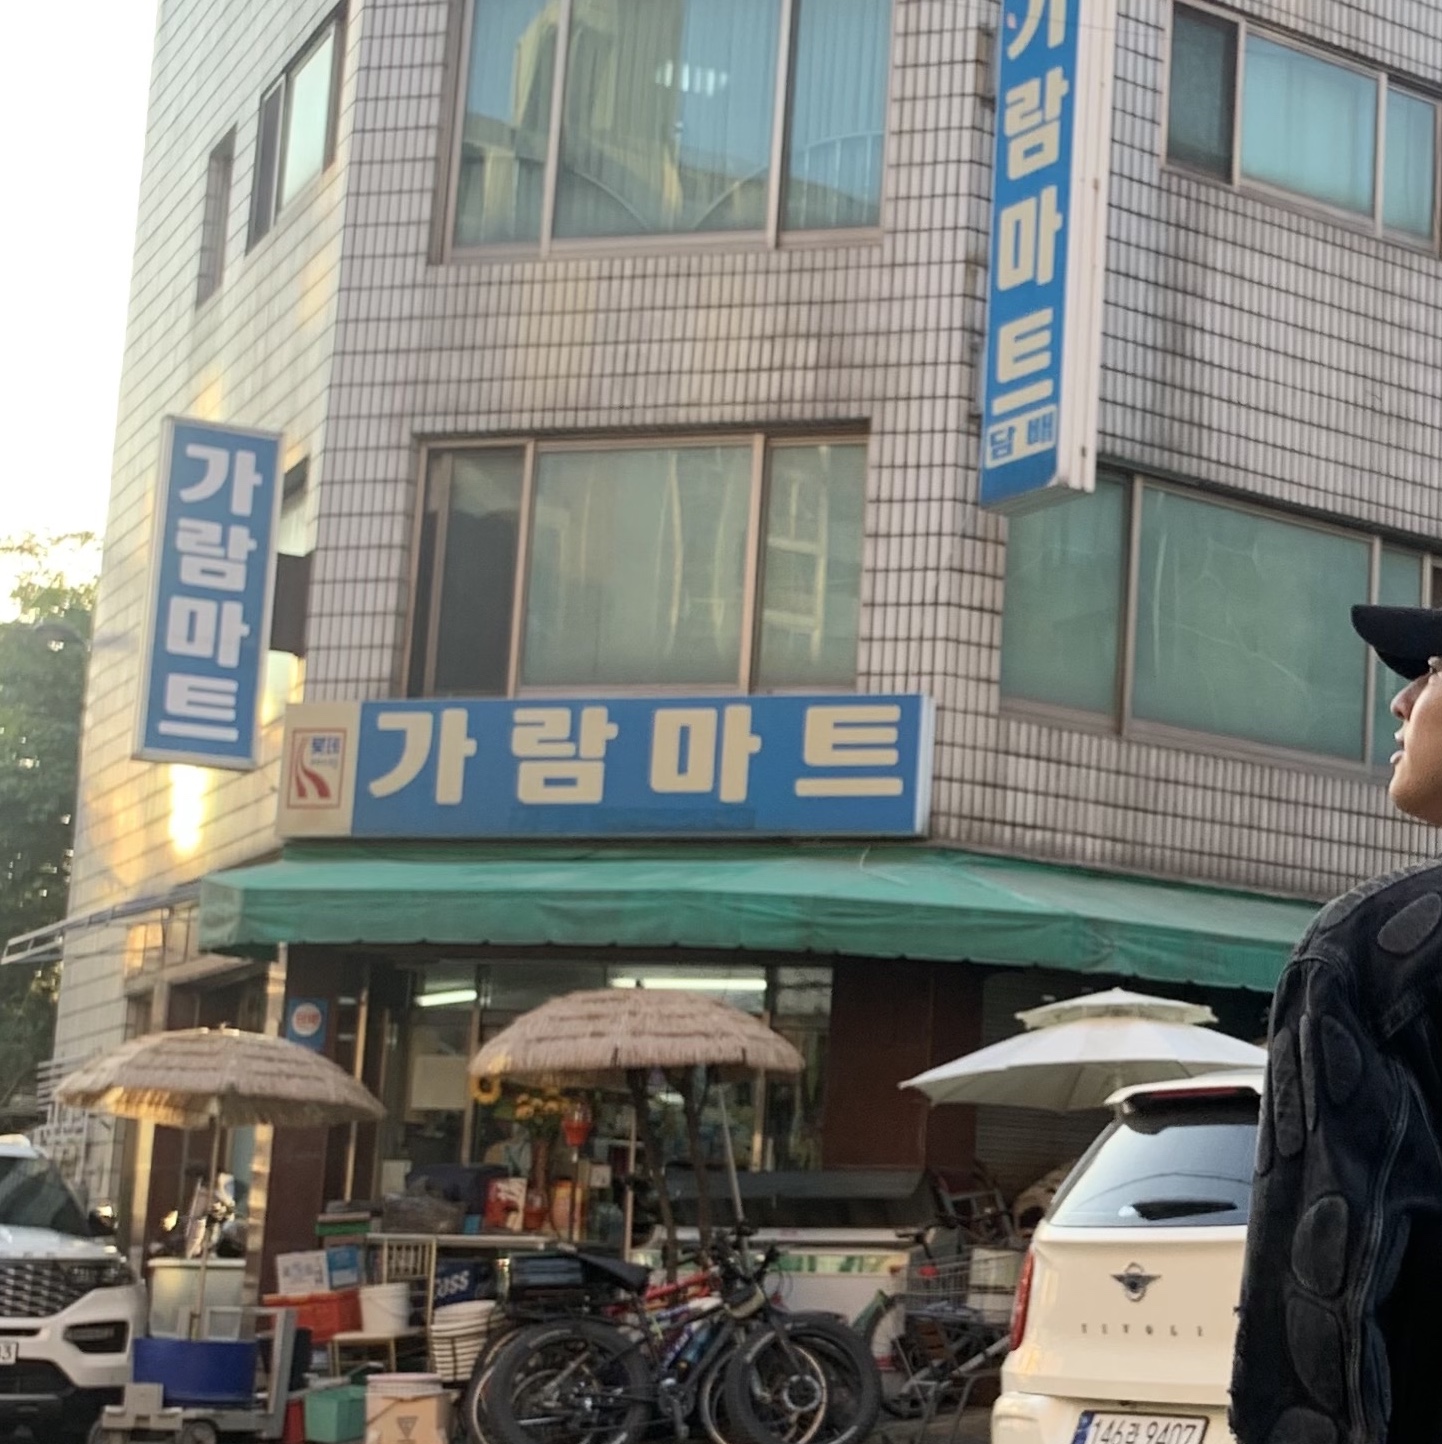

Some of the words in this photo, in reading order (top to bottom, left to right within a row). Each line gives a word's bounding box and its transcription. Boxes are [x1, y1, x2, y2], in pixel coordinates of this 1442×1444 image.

[990, 411, 1054, 461] 담배
[158, 443, 263, 742] 가람마트
[368, 705, 904, 806] 가람마트
